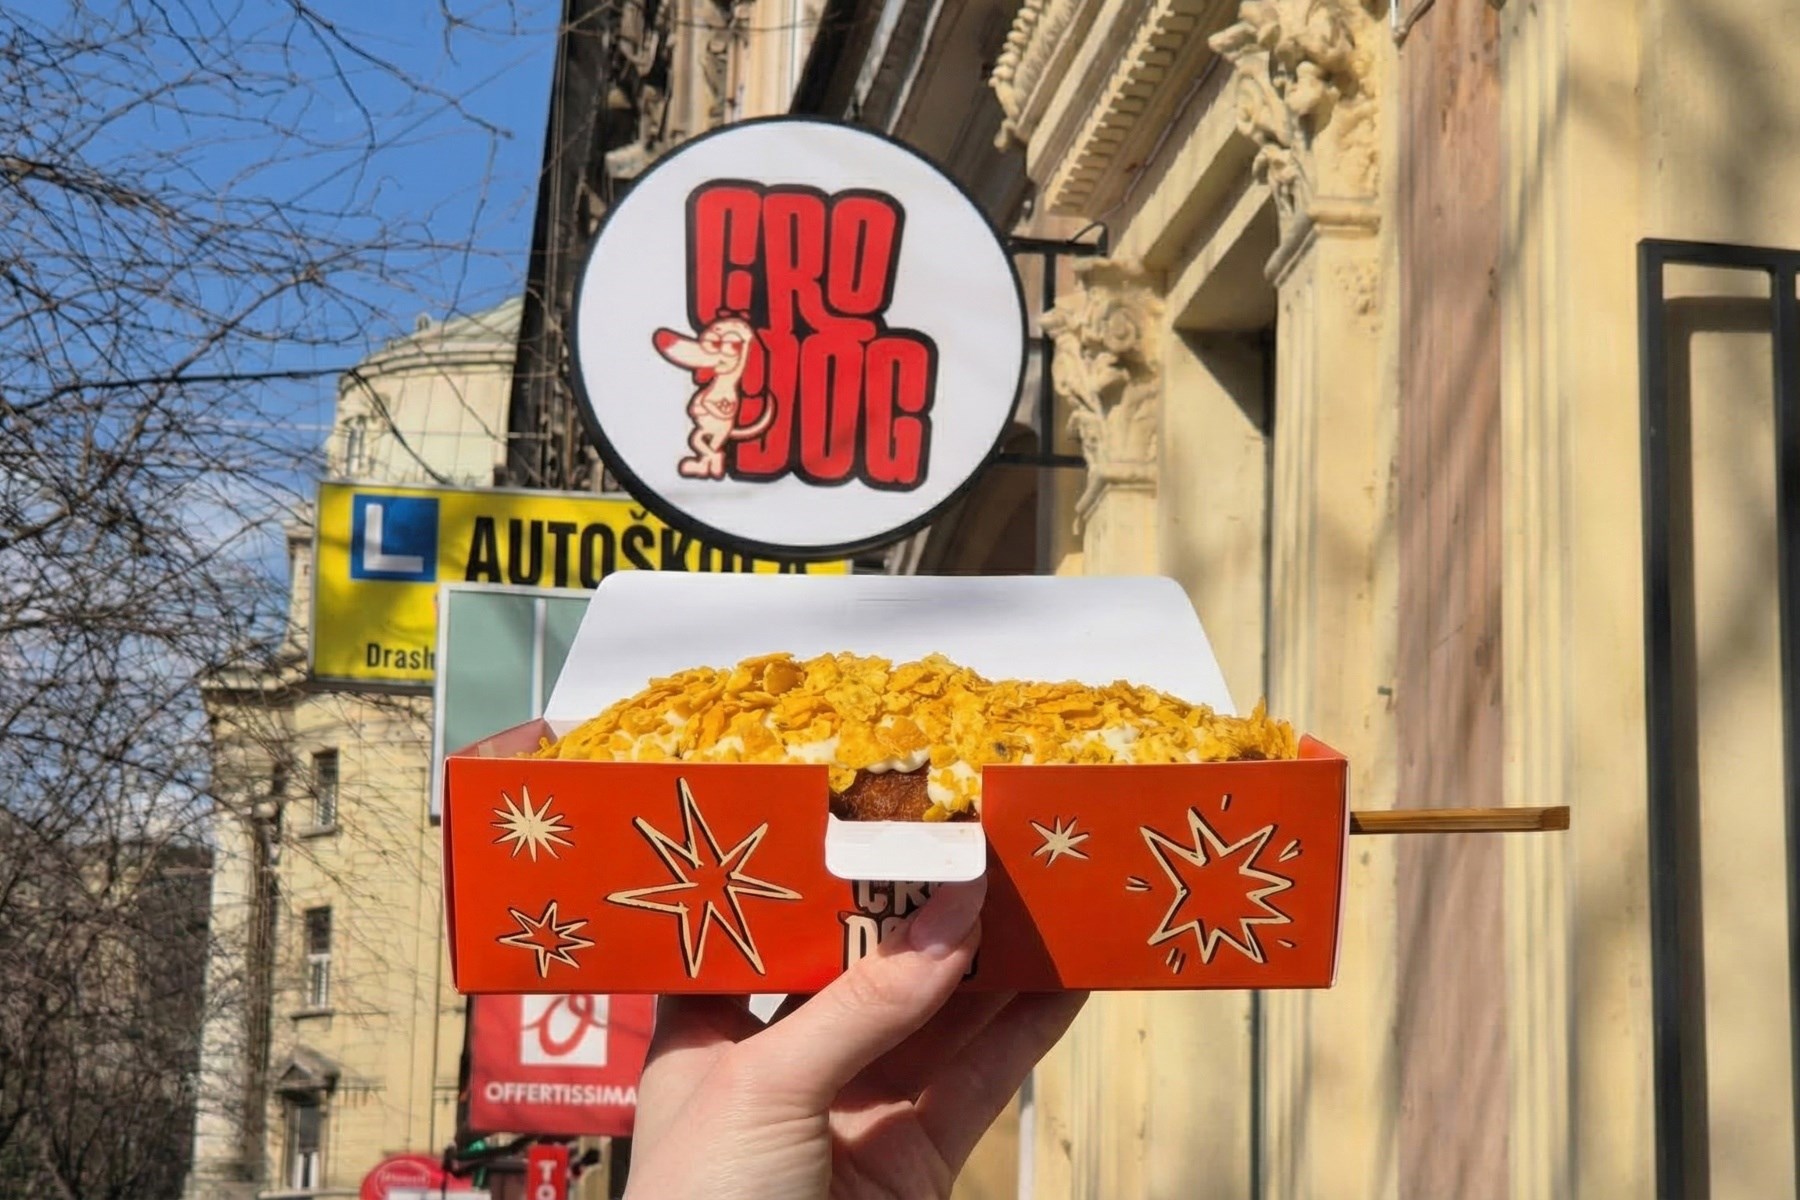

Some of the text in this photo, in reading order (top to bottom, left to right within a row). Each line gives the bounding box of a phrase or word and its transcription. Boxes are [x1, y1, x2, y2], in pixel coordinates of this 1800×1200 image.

[685, 178, 906, 334] CRO
[728, 328, 939, 492] DOG
[485, 1081, 638, 1107] OFFERTISSIMA
